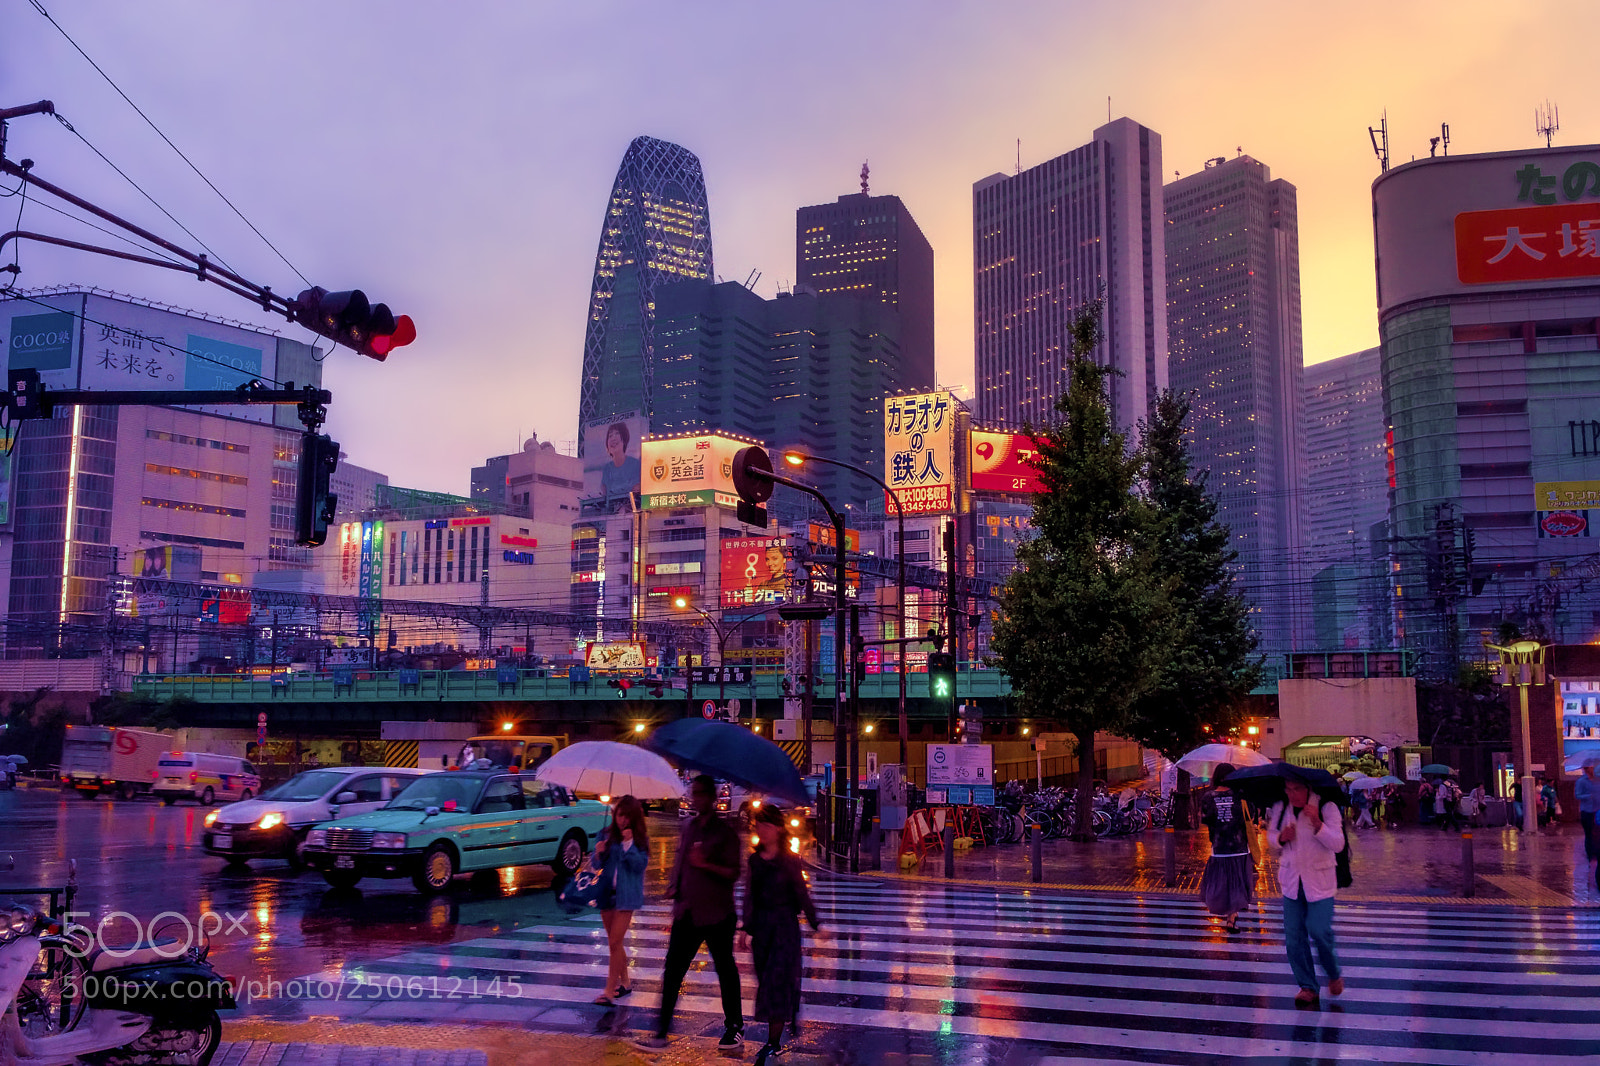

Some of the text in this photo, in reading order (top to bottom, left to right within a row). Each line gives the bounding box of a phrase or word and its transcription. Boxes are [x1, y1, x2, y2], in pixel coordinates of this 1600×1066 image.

[1515, 161, 1600, 205] たの
[1483, 219, 1600, 264] 大塚
[95, 348, 175, 382] 未来を。
[887, 395, 949, 436] カラオケ
[911, 432, 925, 452] の
[671, 453, 705, 467] シェーン
[891, 448, 943, 486] 鉄人
[671, 464, 705, 478] 英会話
[1013, 478, 1026, 489] 2F
[649, 493, 687, 507] 新宿本校
[1564, 490, 1600, 500] ワンカ
